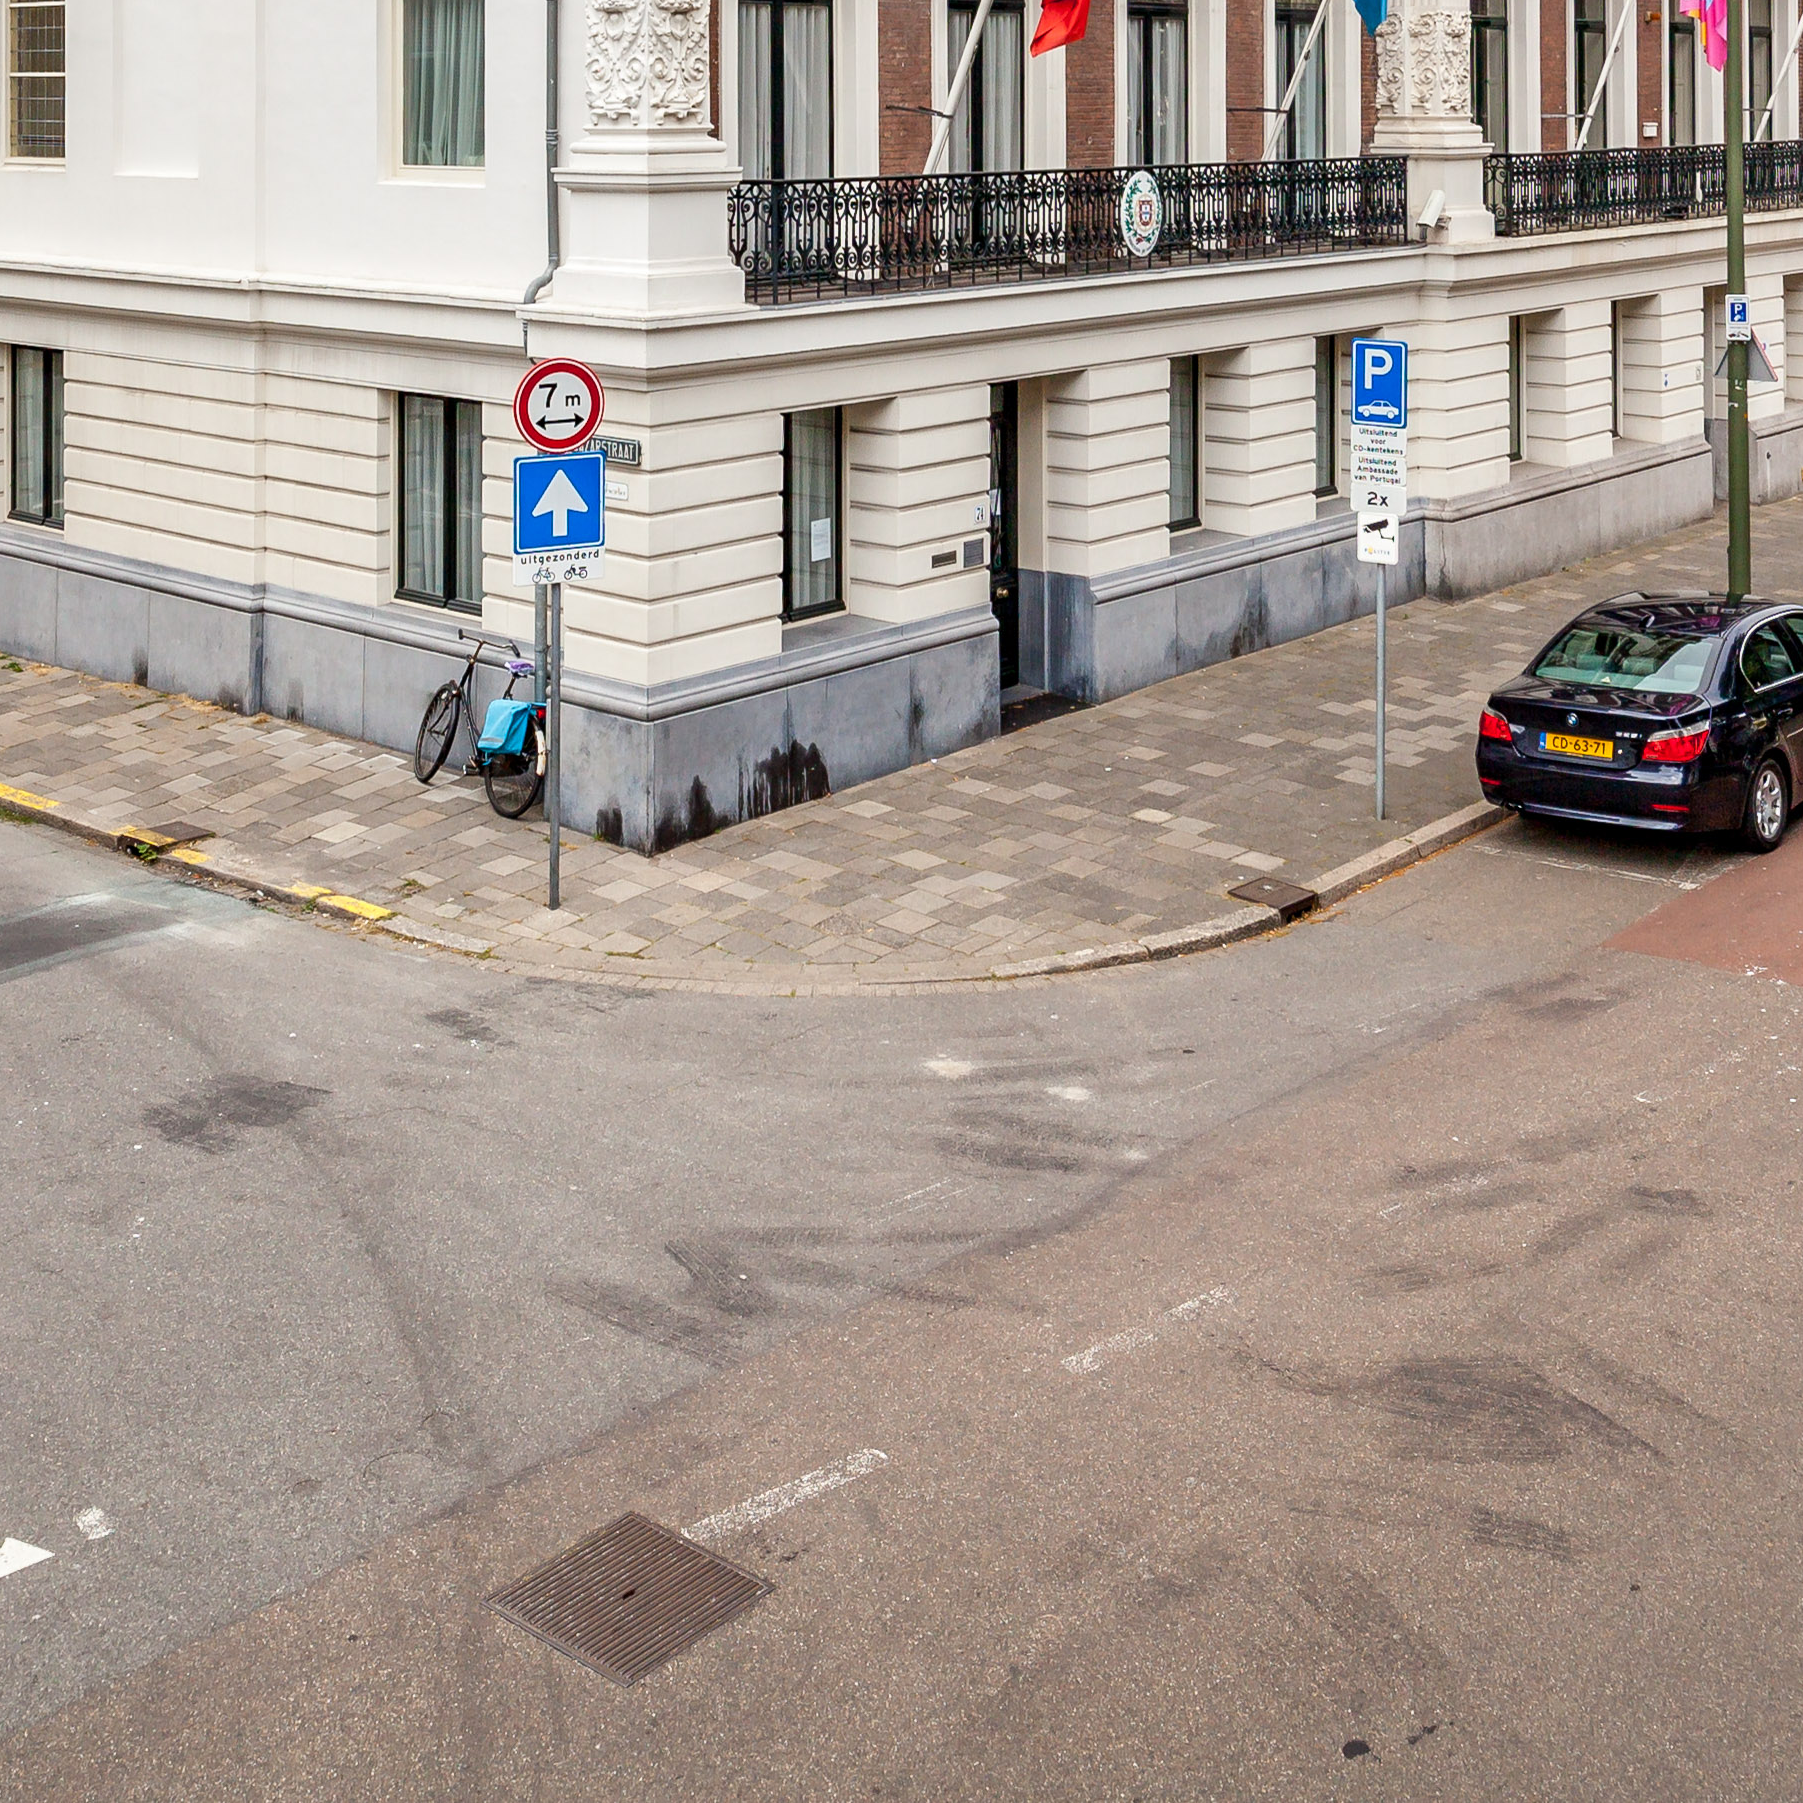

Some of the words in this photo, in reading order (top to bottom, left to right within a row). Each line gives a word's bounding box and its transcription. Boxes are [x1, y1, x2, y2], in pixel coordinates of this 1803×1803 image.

[1734, 304, 1742, 314] P
[1364, 348, 1393, 389] P
[538, 383, 558, 408] 7
[565, 393, 581, 407] m
[1359, 428, 1398, 437] Uitsluitend
[574, 439, 634, 460] ZARSTRAAT
[1358, 457, 1397, 466] Uitsluitend
[1357, 466, 1399, 475] Ambassade
[1370, 475, 1401, 485] Portugal
[1367, 492, 1389, 507] 2x
[976, 507, 985, 521] 74
[520, 549, 600, 565] uitgezonderd
[1552, 736, 1606, 755] CD-63-71
